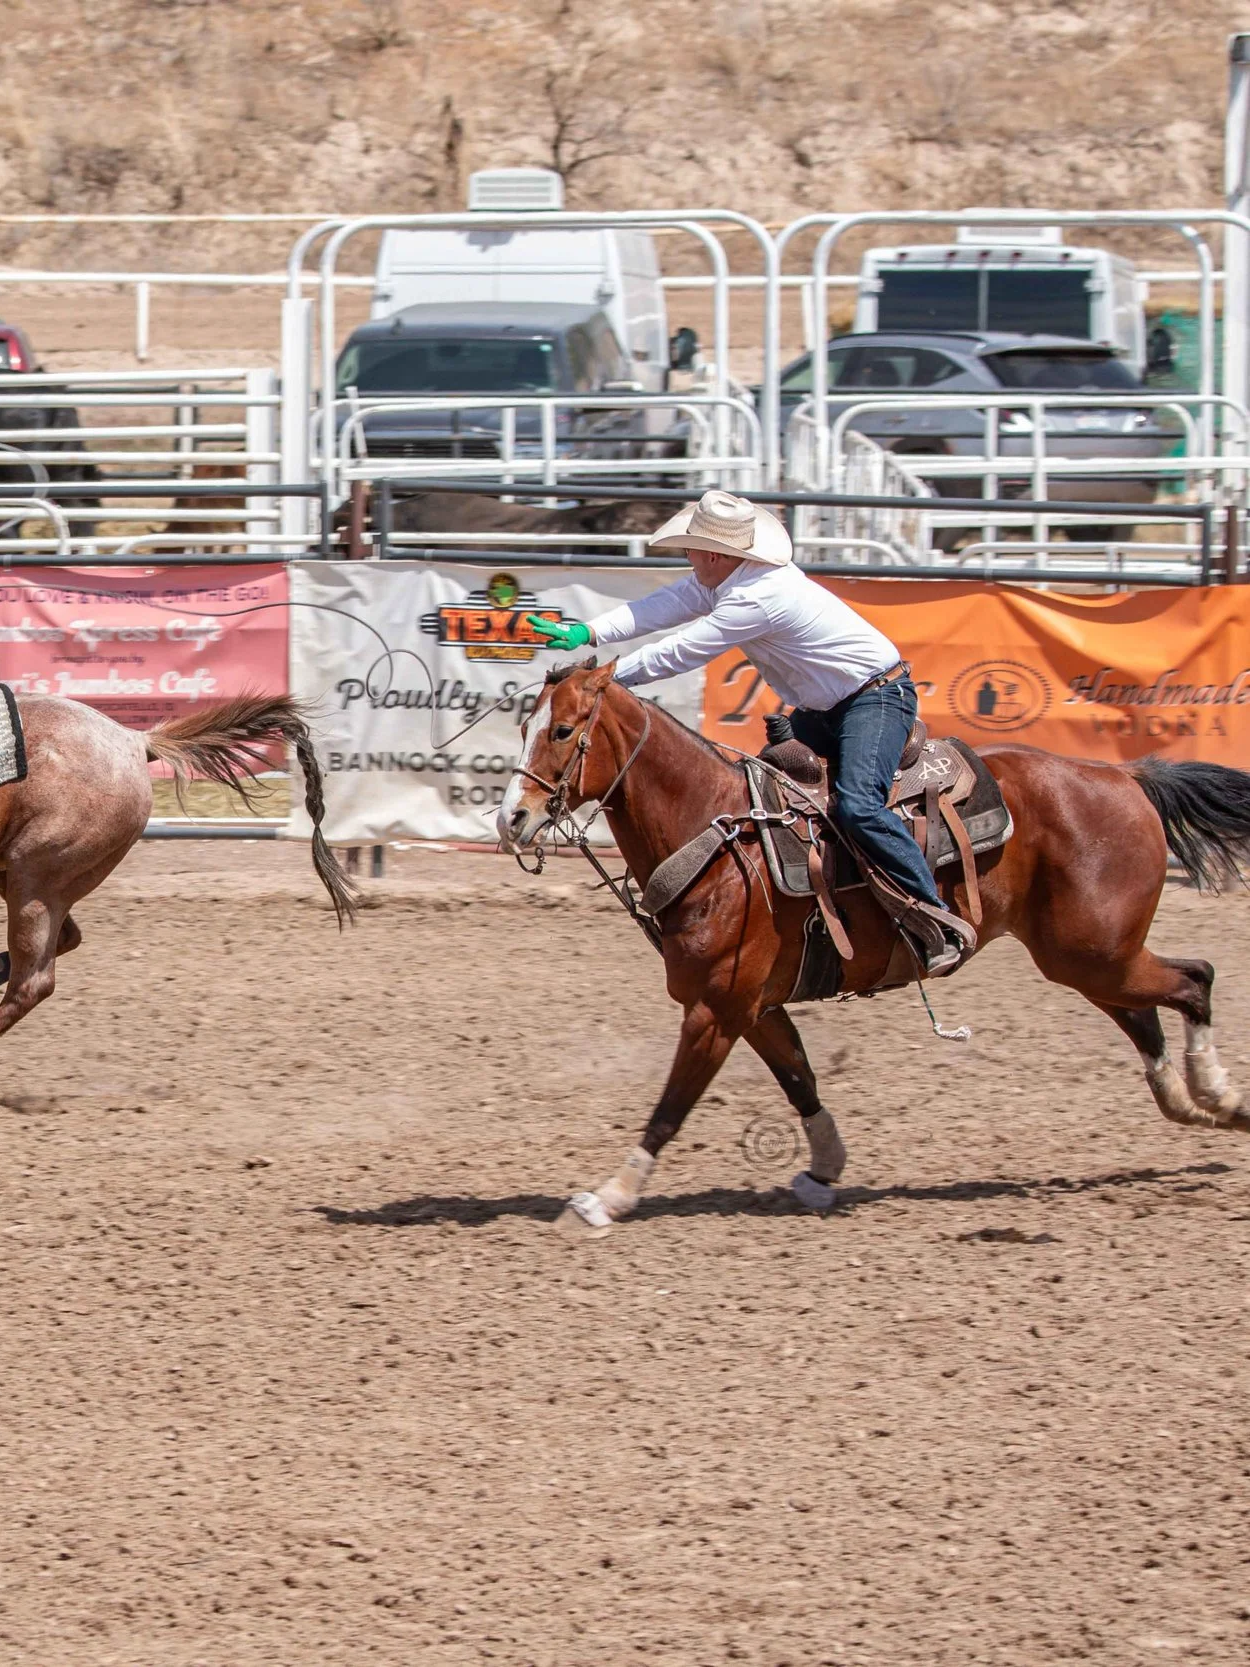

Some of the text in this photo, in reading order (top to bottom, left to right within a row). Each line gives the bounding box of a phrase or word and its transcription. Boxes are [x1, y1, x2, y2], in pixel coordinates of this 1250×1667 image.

[336, 678, 484, 725] Proudly
[1090, 713, 1228, 737] VODKA
[329, 752, 463, 774] BANNOCK
[448, 785, 507, 806] ROD
